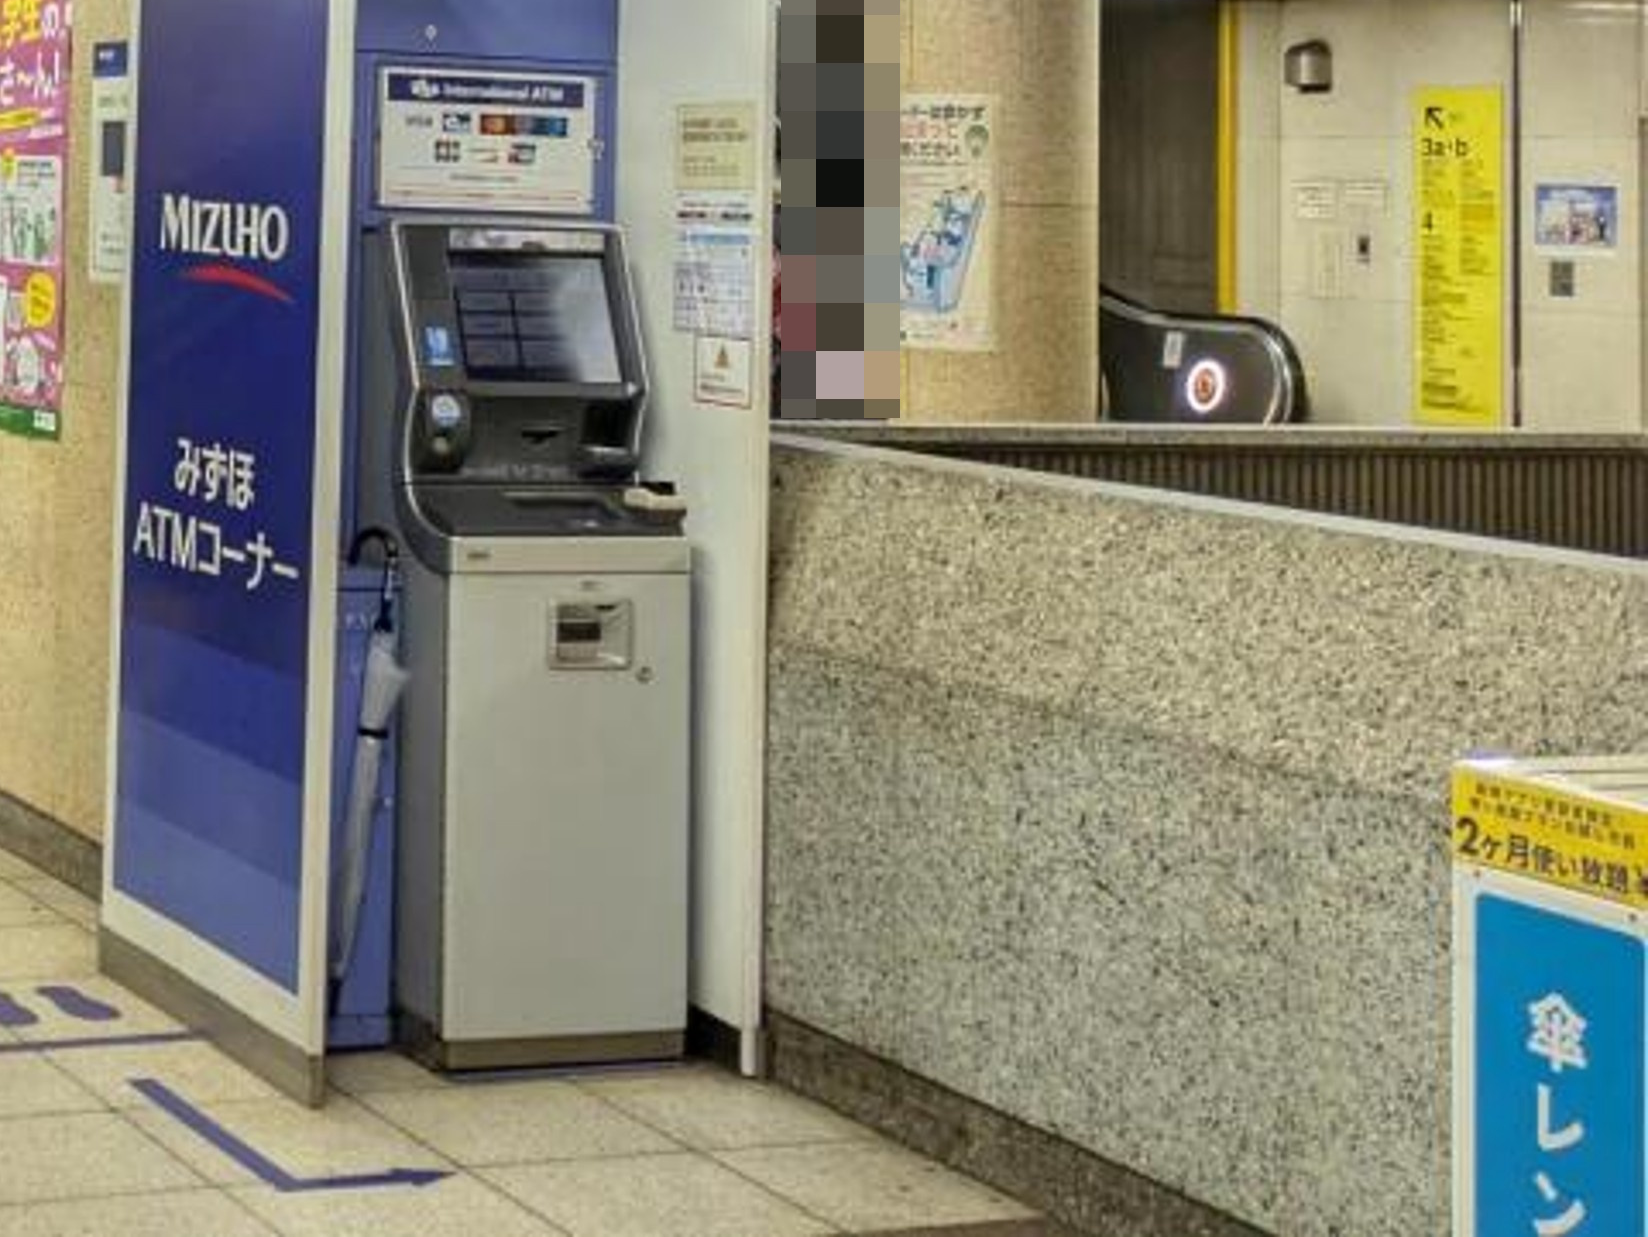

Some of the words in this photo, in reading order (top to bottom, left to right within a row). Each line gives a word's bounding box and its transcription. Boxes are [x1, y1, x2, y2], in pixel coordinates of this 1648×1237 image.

[159, 192, 290, 261] MIZUHO
[174, 437, 256, 512] みずほ
[133, 501, 300, 591] ATMコーナー
